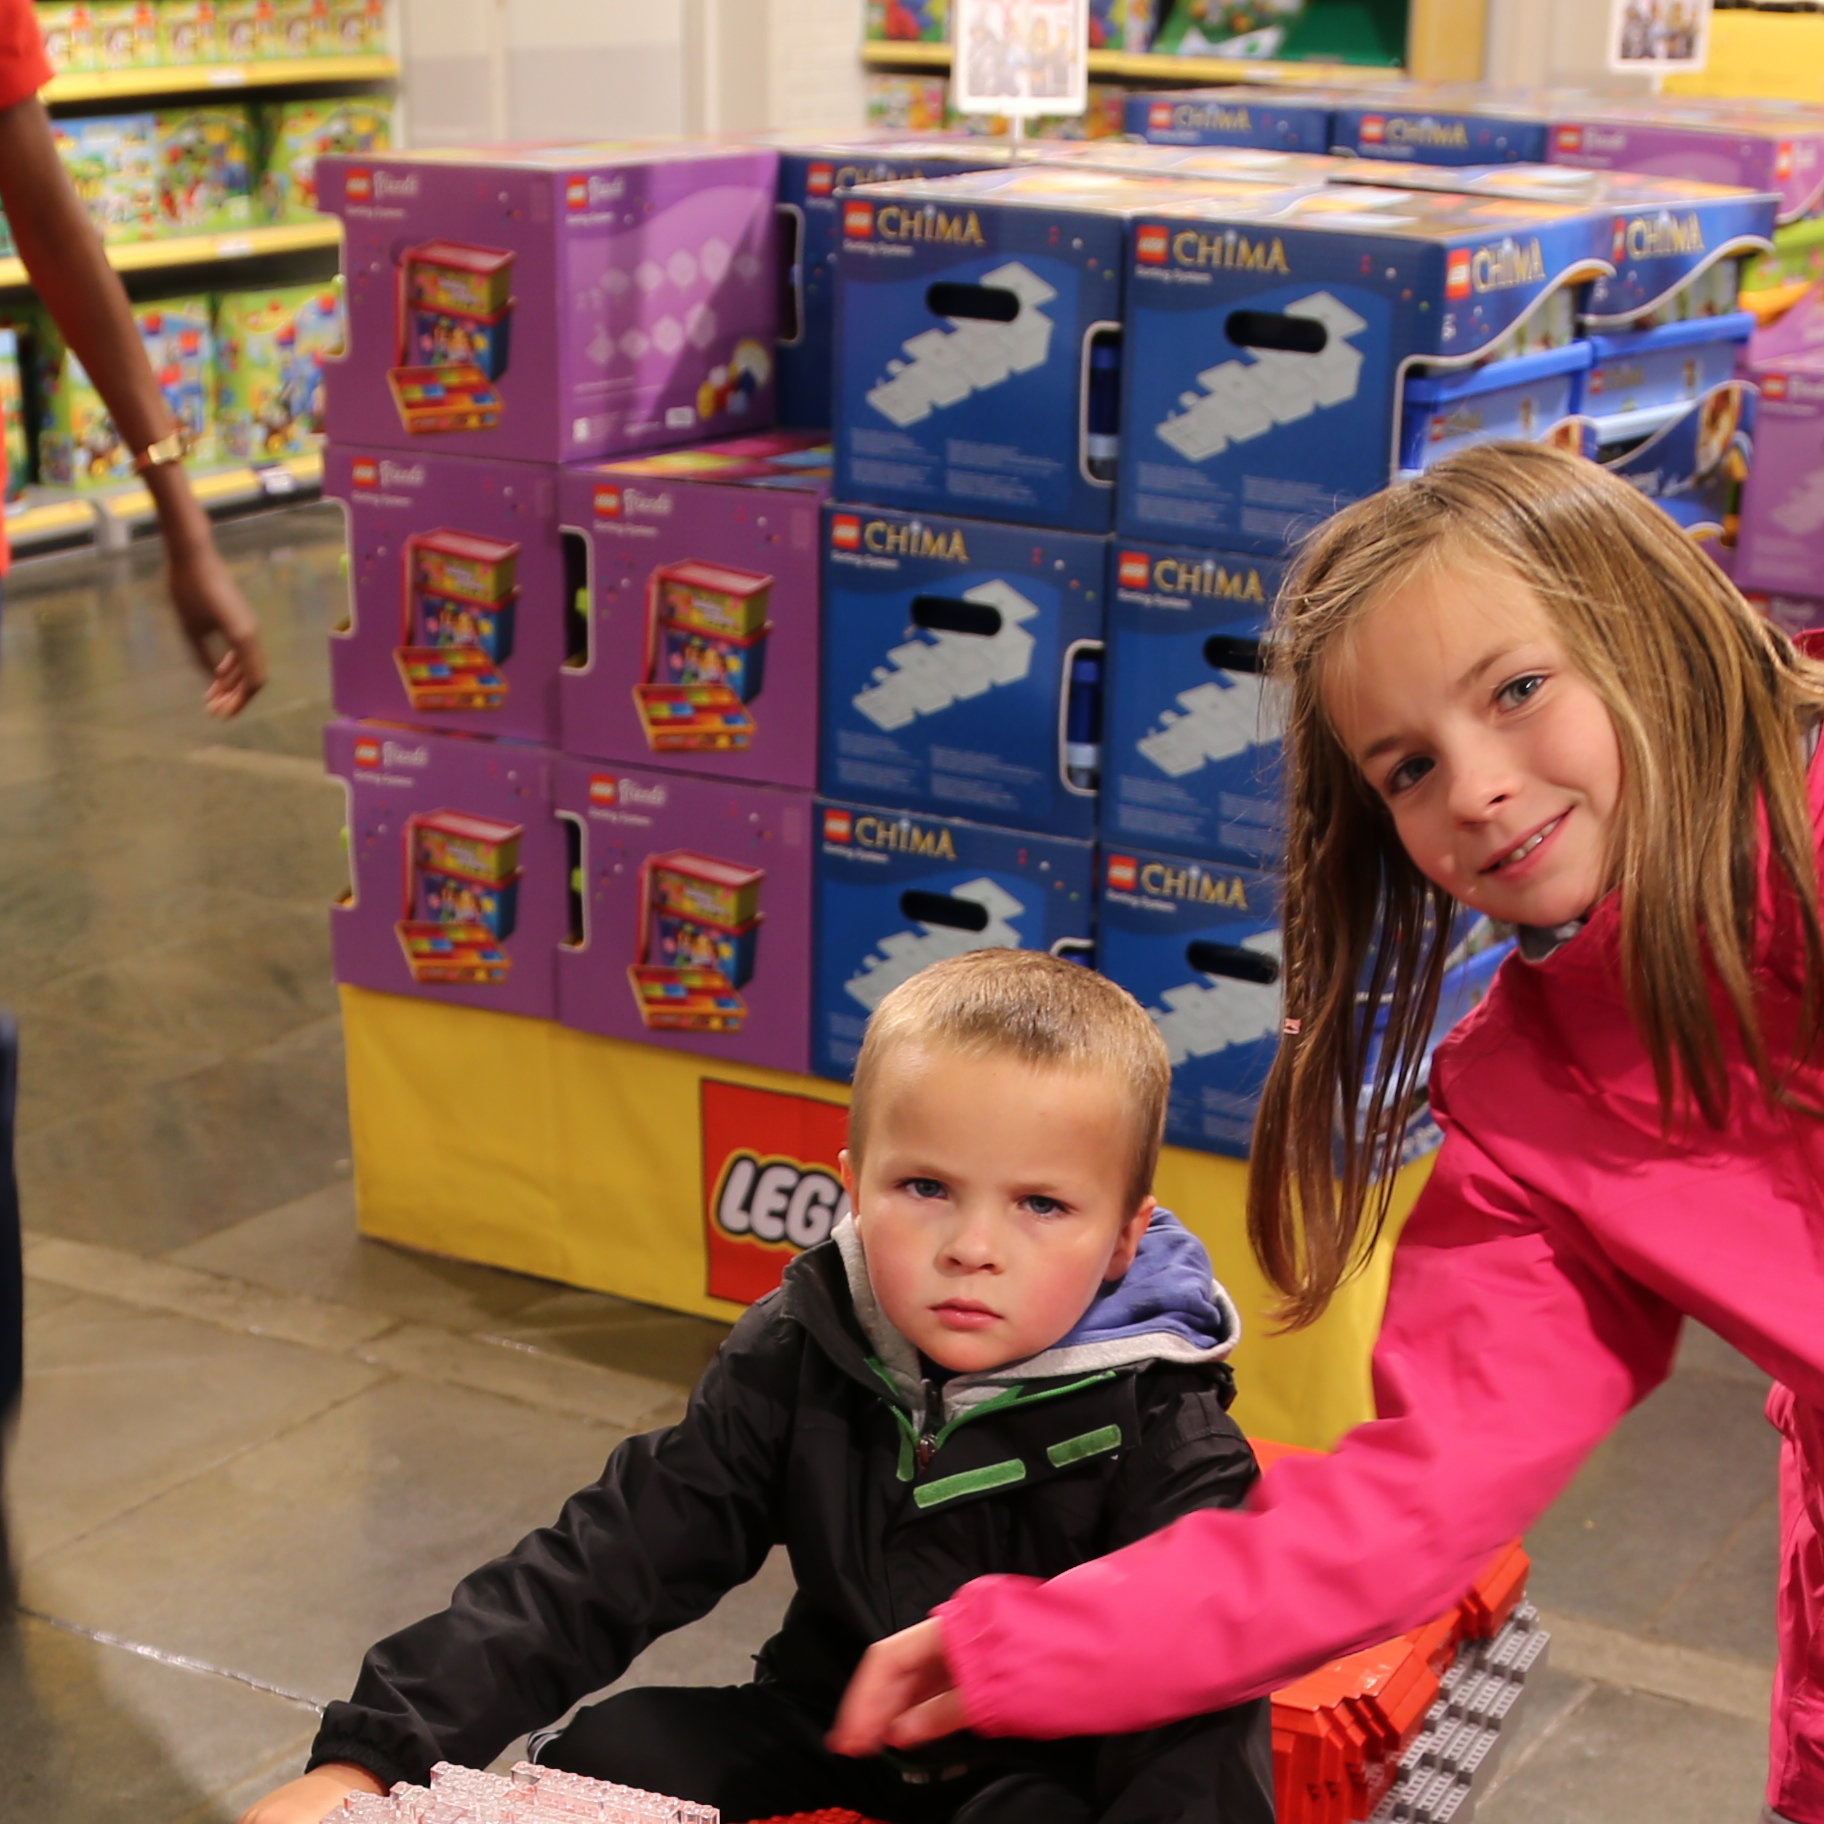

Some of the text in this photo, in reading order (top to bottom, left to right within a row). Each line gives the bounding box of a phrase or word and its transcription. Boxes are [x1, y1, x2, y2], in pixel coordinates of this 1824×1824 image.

[877, 203, 987, 247] CHIMA
[1172, 228, 1291, 275] CHIMA
[864, 519, 971, 565] CHIMA
[1152, 556, 1267, 605] CHIMA
[854, 814, 957, 861] CHIMA
[1140, 861, 1249, 911] CHIMA
